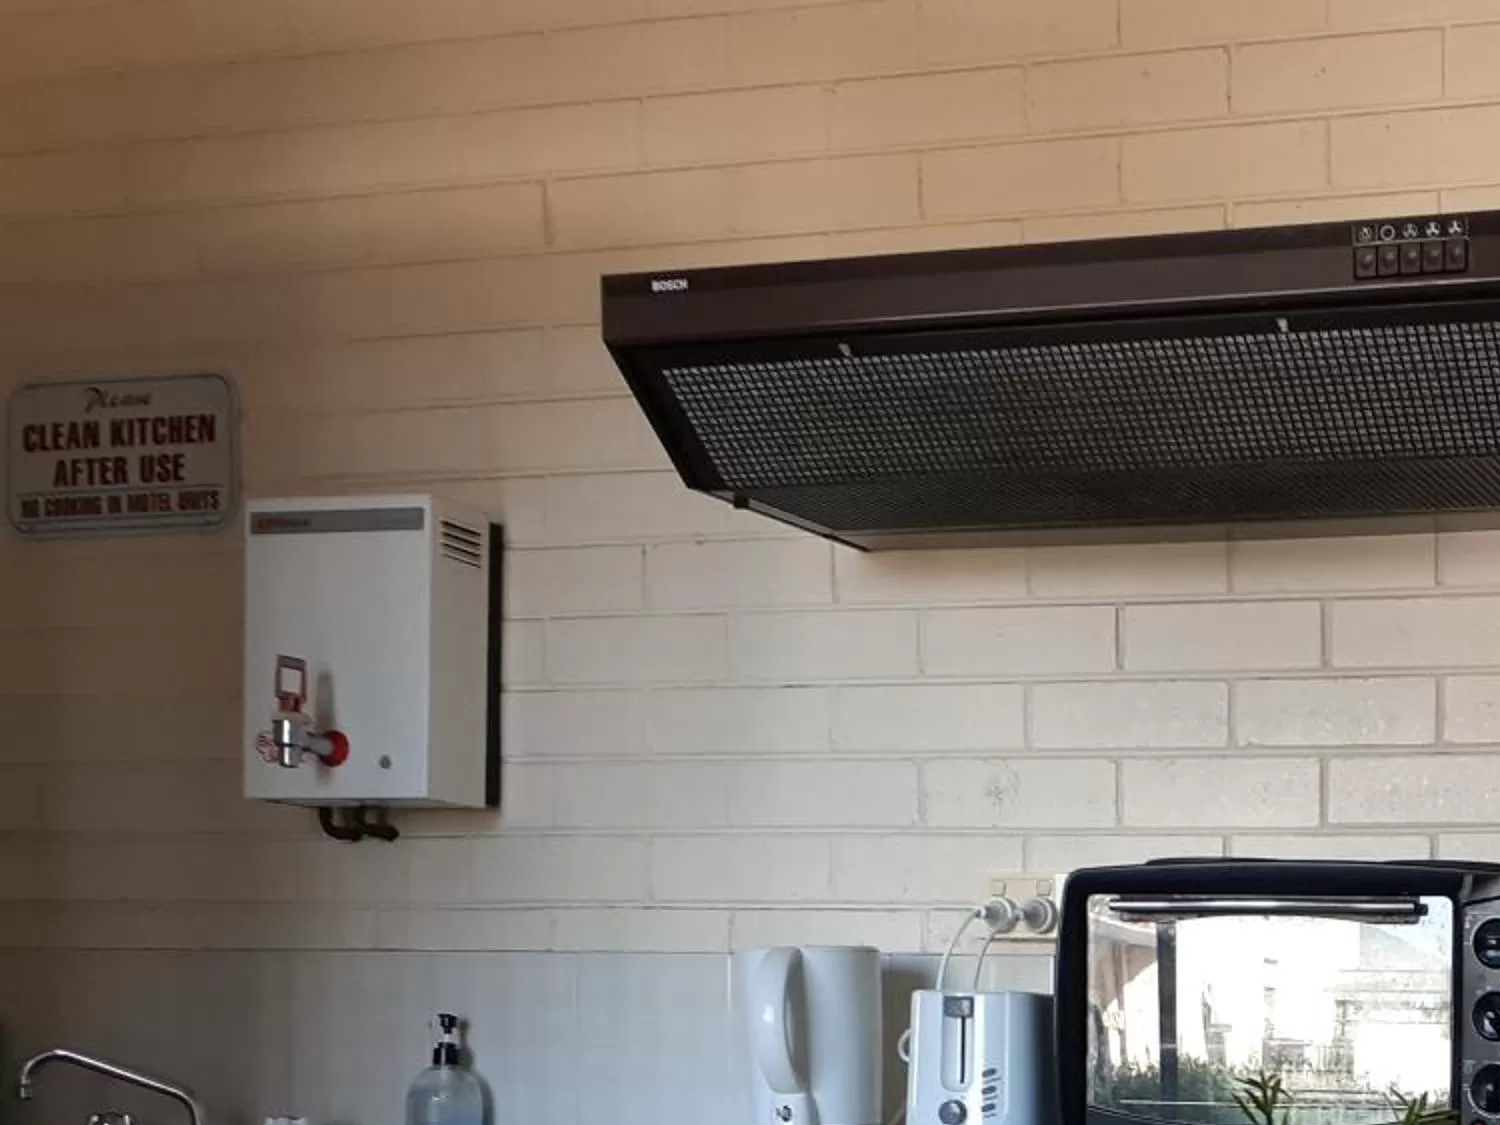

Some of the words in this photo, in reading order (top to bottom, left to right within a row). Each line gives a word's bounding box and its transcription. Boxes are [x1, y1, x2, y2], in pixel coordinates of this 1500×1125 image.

[22, 420, 99, 452] CLEAN
[109, 413, 217, 448] KITCHEN
[53, 456, 129, 487] AFTER
[139, 453, 186, 484] USE
